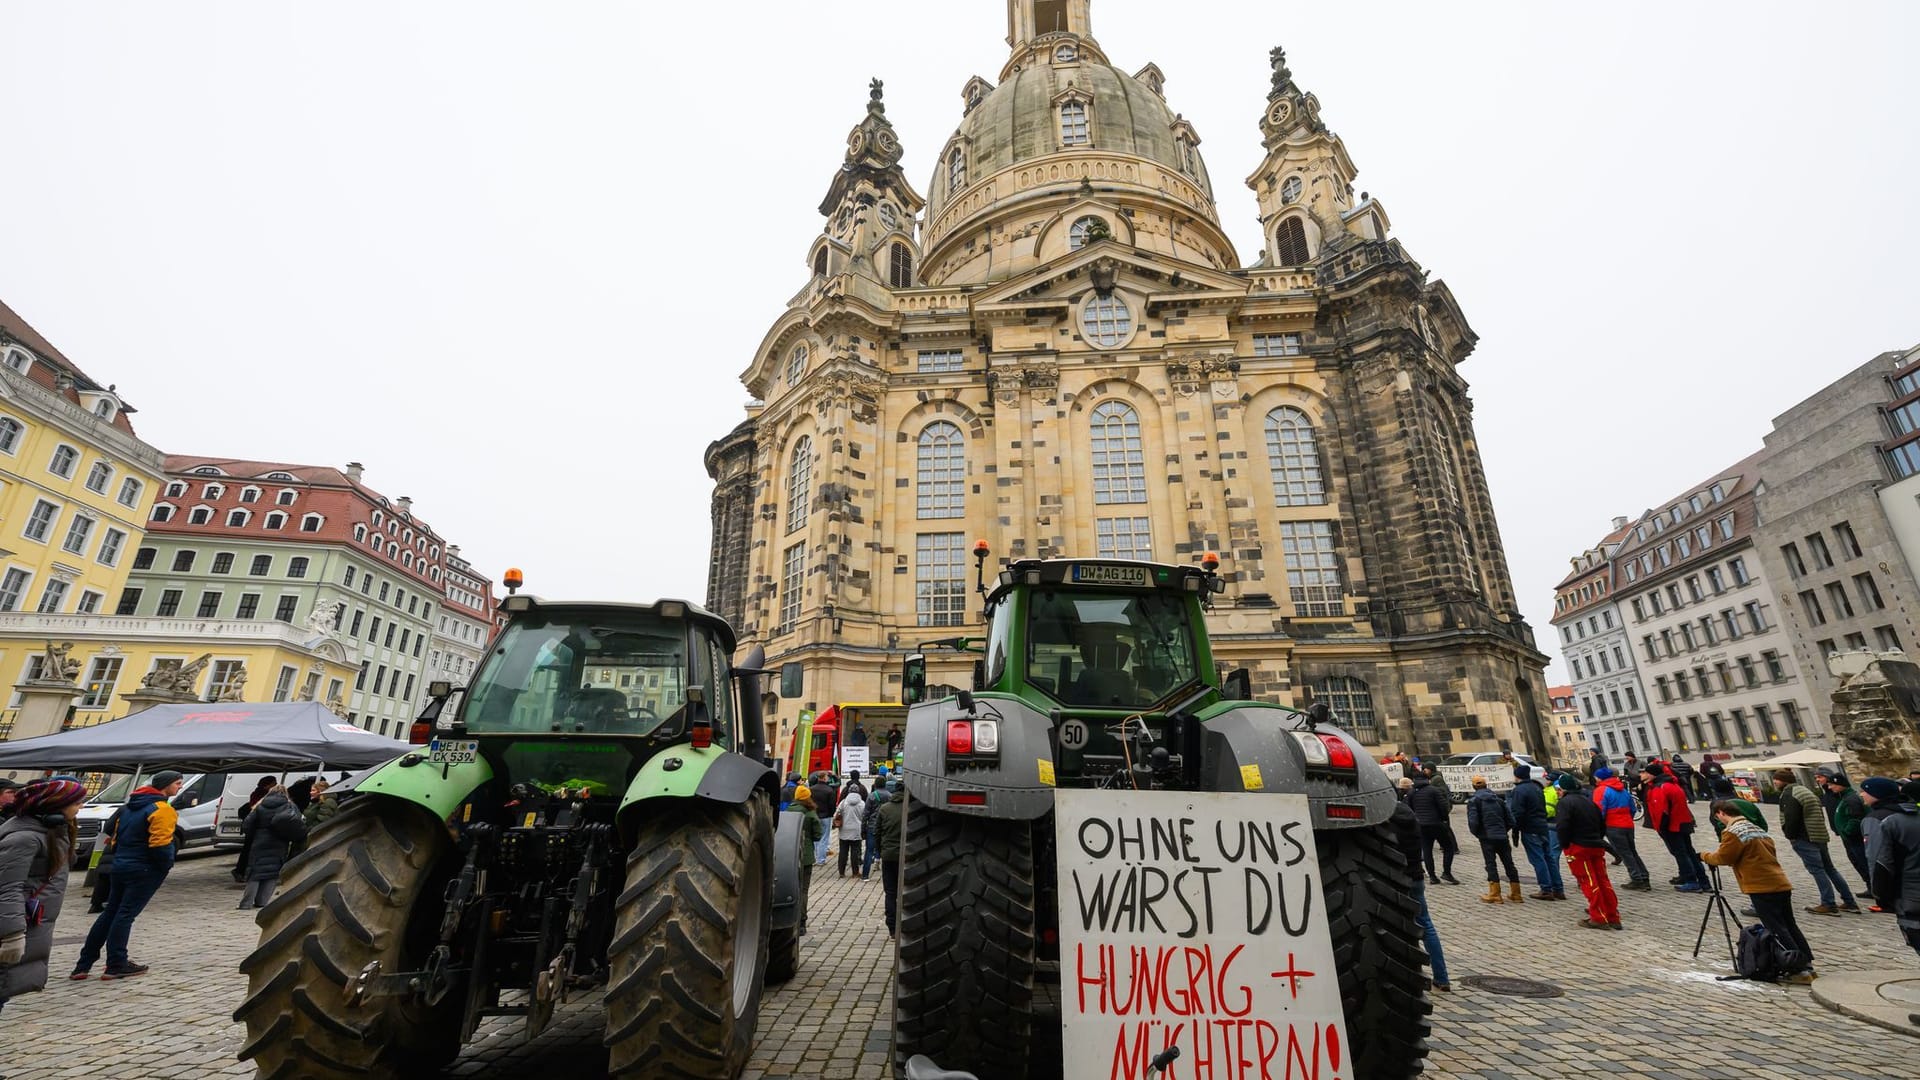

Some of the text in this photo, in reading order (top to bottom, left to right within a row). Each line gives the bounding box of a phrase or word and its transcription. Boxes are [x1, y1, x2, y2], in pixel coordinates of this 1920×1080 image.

[1080, 567, 1143, 581] DW AG 116
[1064, 725, 1082, 745] 50
[439, 741, 460, 752] MEI
[433, 752, 471, 762] CK 539
[1078, 817, 1306, 867] OHNE UNS
[1072, 861, 1312, 938] WÄRST DU
[1077, 942, 1253, 1017] HUNGRIG
